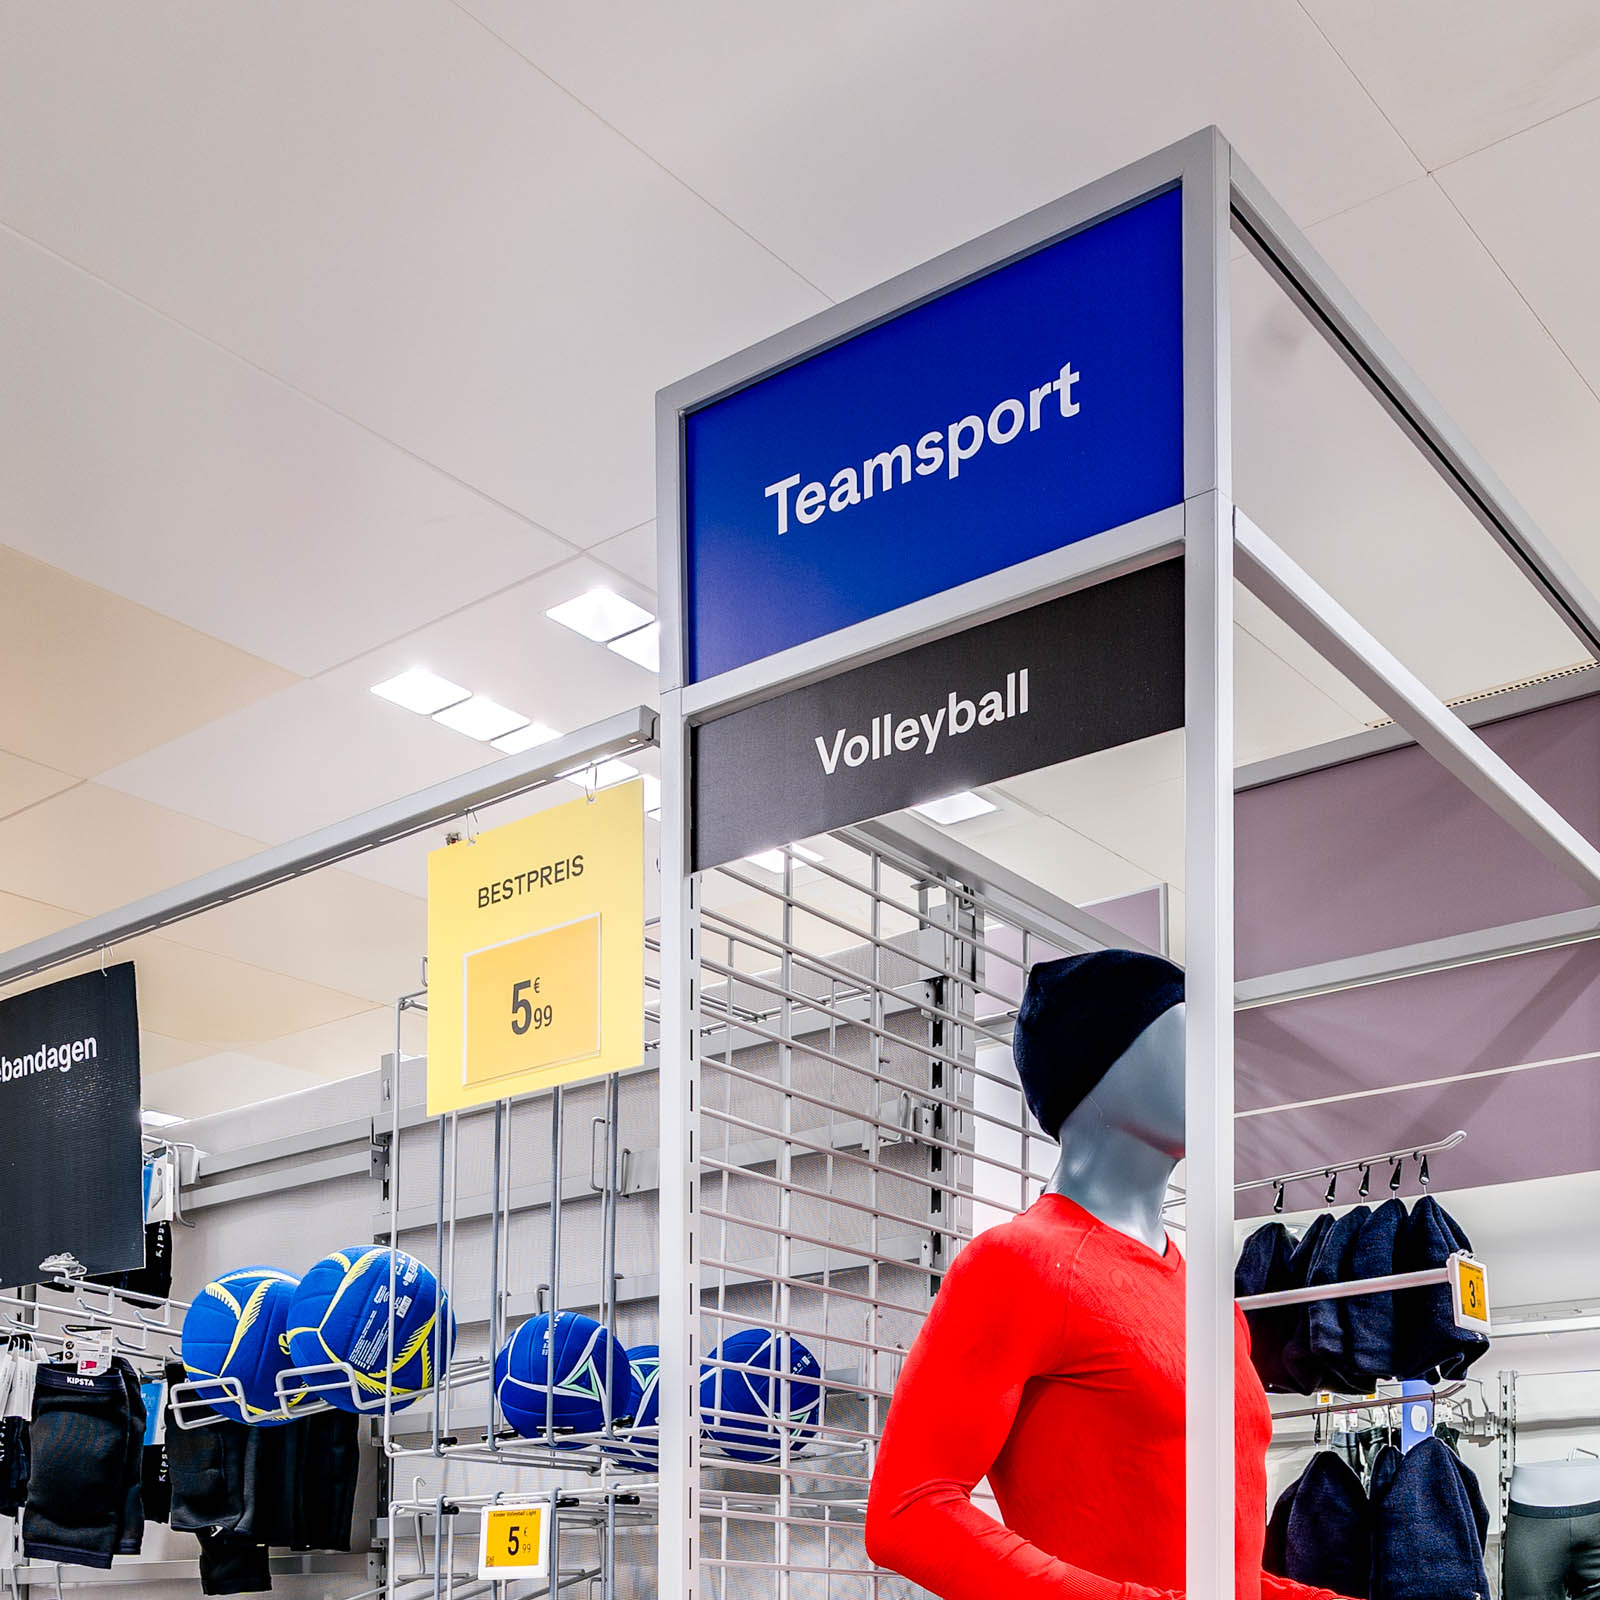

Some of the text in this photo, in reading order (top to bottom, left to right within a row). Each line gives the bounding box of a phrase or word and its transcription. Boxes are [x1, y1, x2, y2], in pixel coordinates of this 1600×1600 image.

[764, 361, 1080, 536] Teamsport
[814, 667, 1030, 776] Volleyball
[477, 855, 584, 909] BESTPREIS
[66, 1376, 94, 1387] KIPSTA
